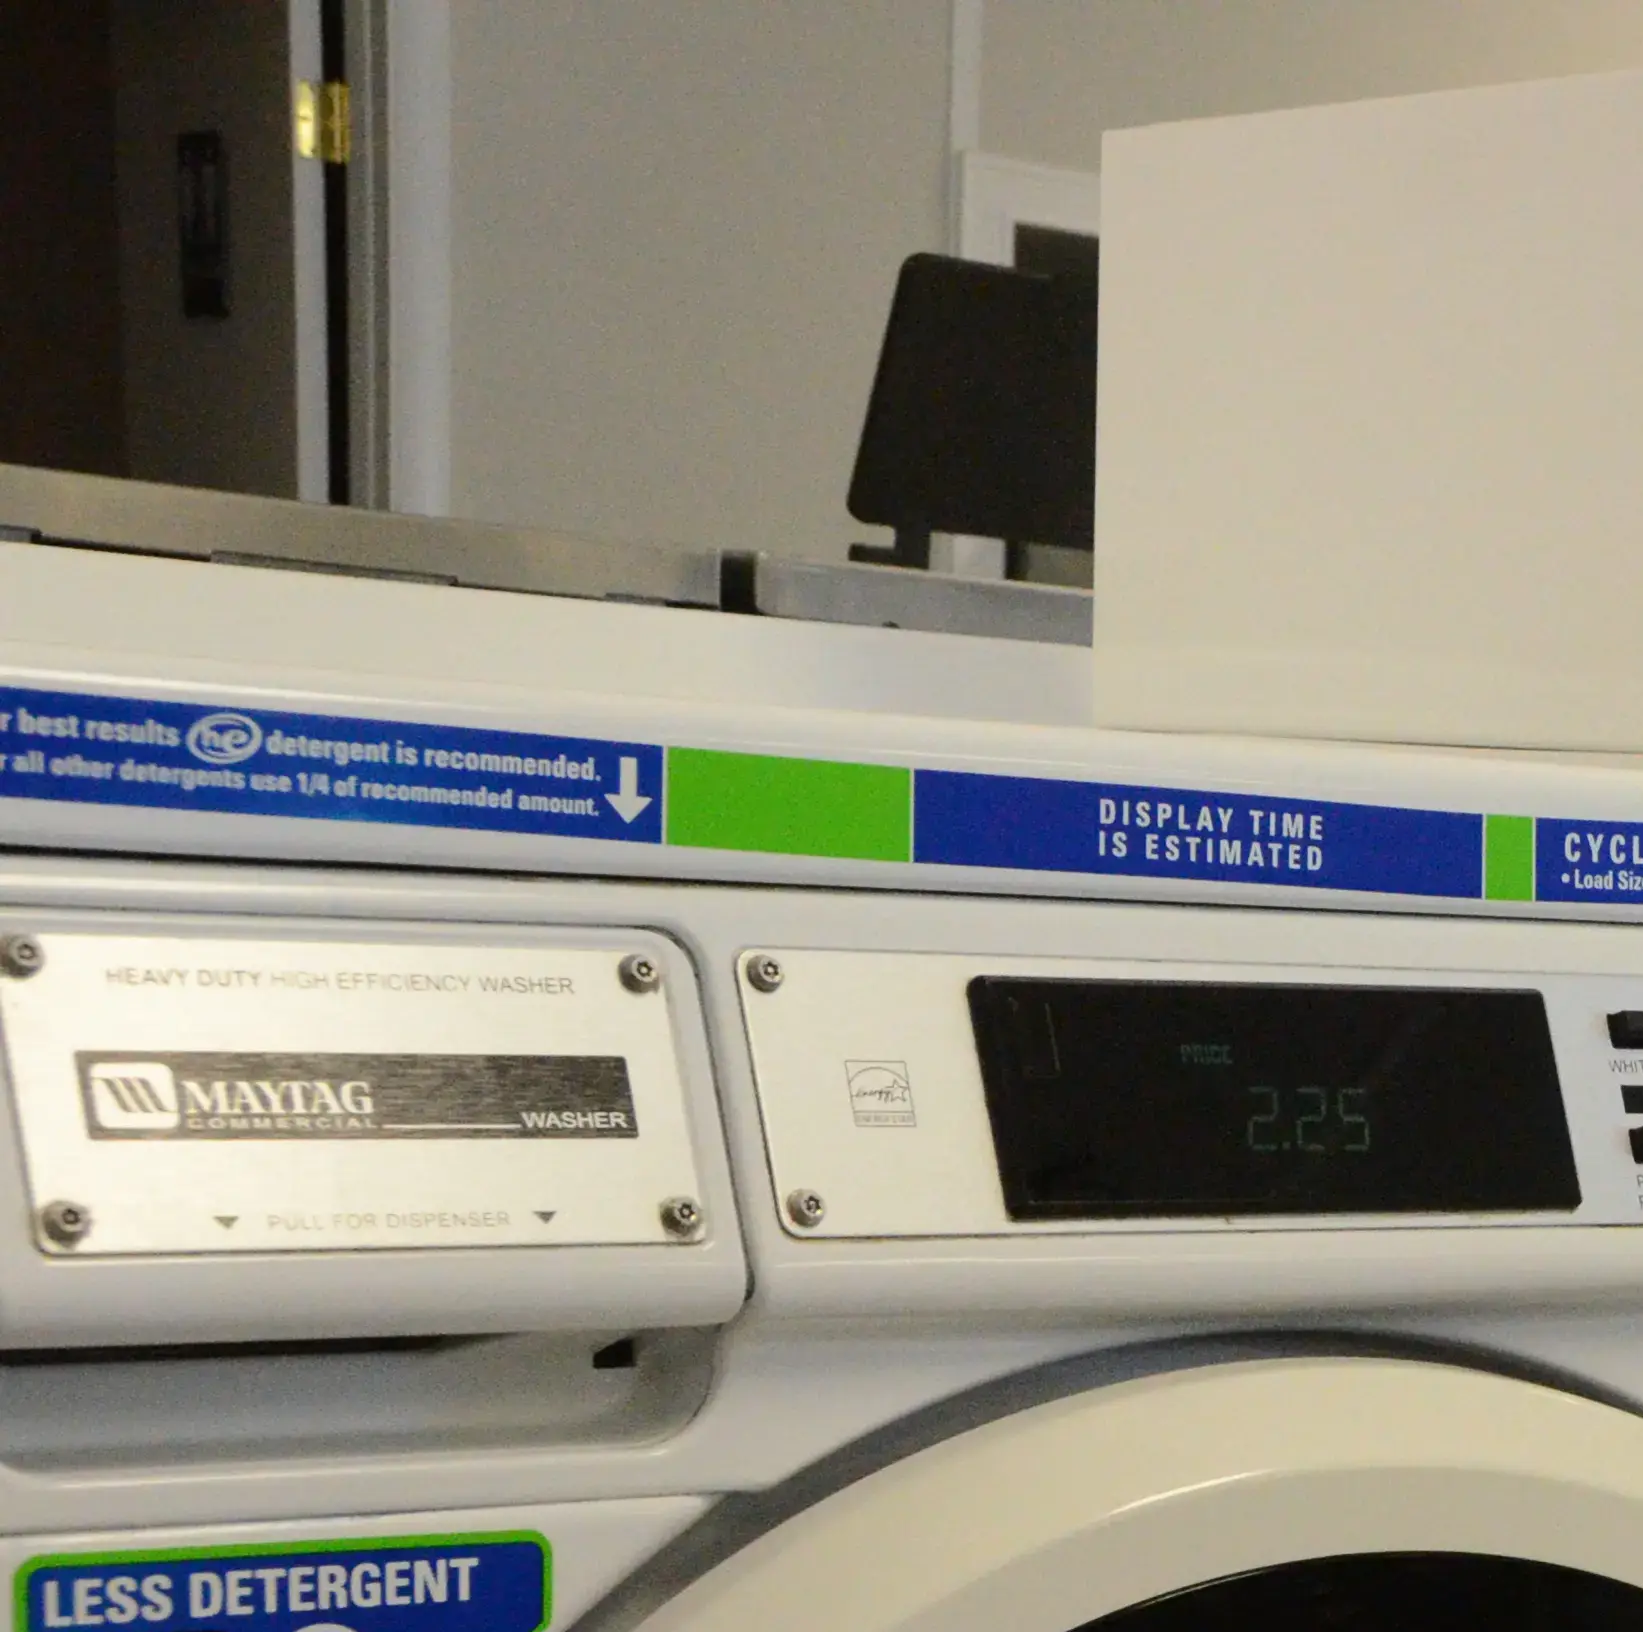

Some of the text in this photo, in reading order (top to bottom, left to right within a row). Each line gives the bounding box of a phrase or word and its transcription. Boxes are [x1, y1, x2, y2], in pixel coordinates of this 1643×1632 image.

[17, 707, 79, 738] best
[85, 719, 181, 747] results
[265, 730, 389, 767] detergent
[396, 740, 418, 766] is
[424, 746, 601, 782] recommended.
[13, 750, 45, 774] all
[50, 754, 114, 779] other
[119, 759, 246, 791] detergents
[250, 773, 292, 793] use
[297, 772, 330, 797] 1/4
[333, 777, 358, 798] of
[362, 782, 513, 810] recommended
[518, 794, 600, 817] amount.
[1099, 798, 1324, 841] DISPLAY TIME
[1098, 830, 1324, 872] IS ESTIMATED
[1573, 869, 1613, 890] Load
[106, 967, 575, 995] HEAVY DUTY HIGH EFFICIENCY WASHER
[181, 1080, 375, 1115] MAYTAG
[1248, 1086, 1370, 1150] 2.25
[187, 1111, 629, 1130] COMMERCIAL WASHER
[268, 1211, 511, 1231] PULL FOR DISPENSER
[43, 1557, 480, 1628] LESS DETERGENT
